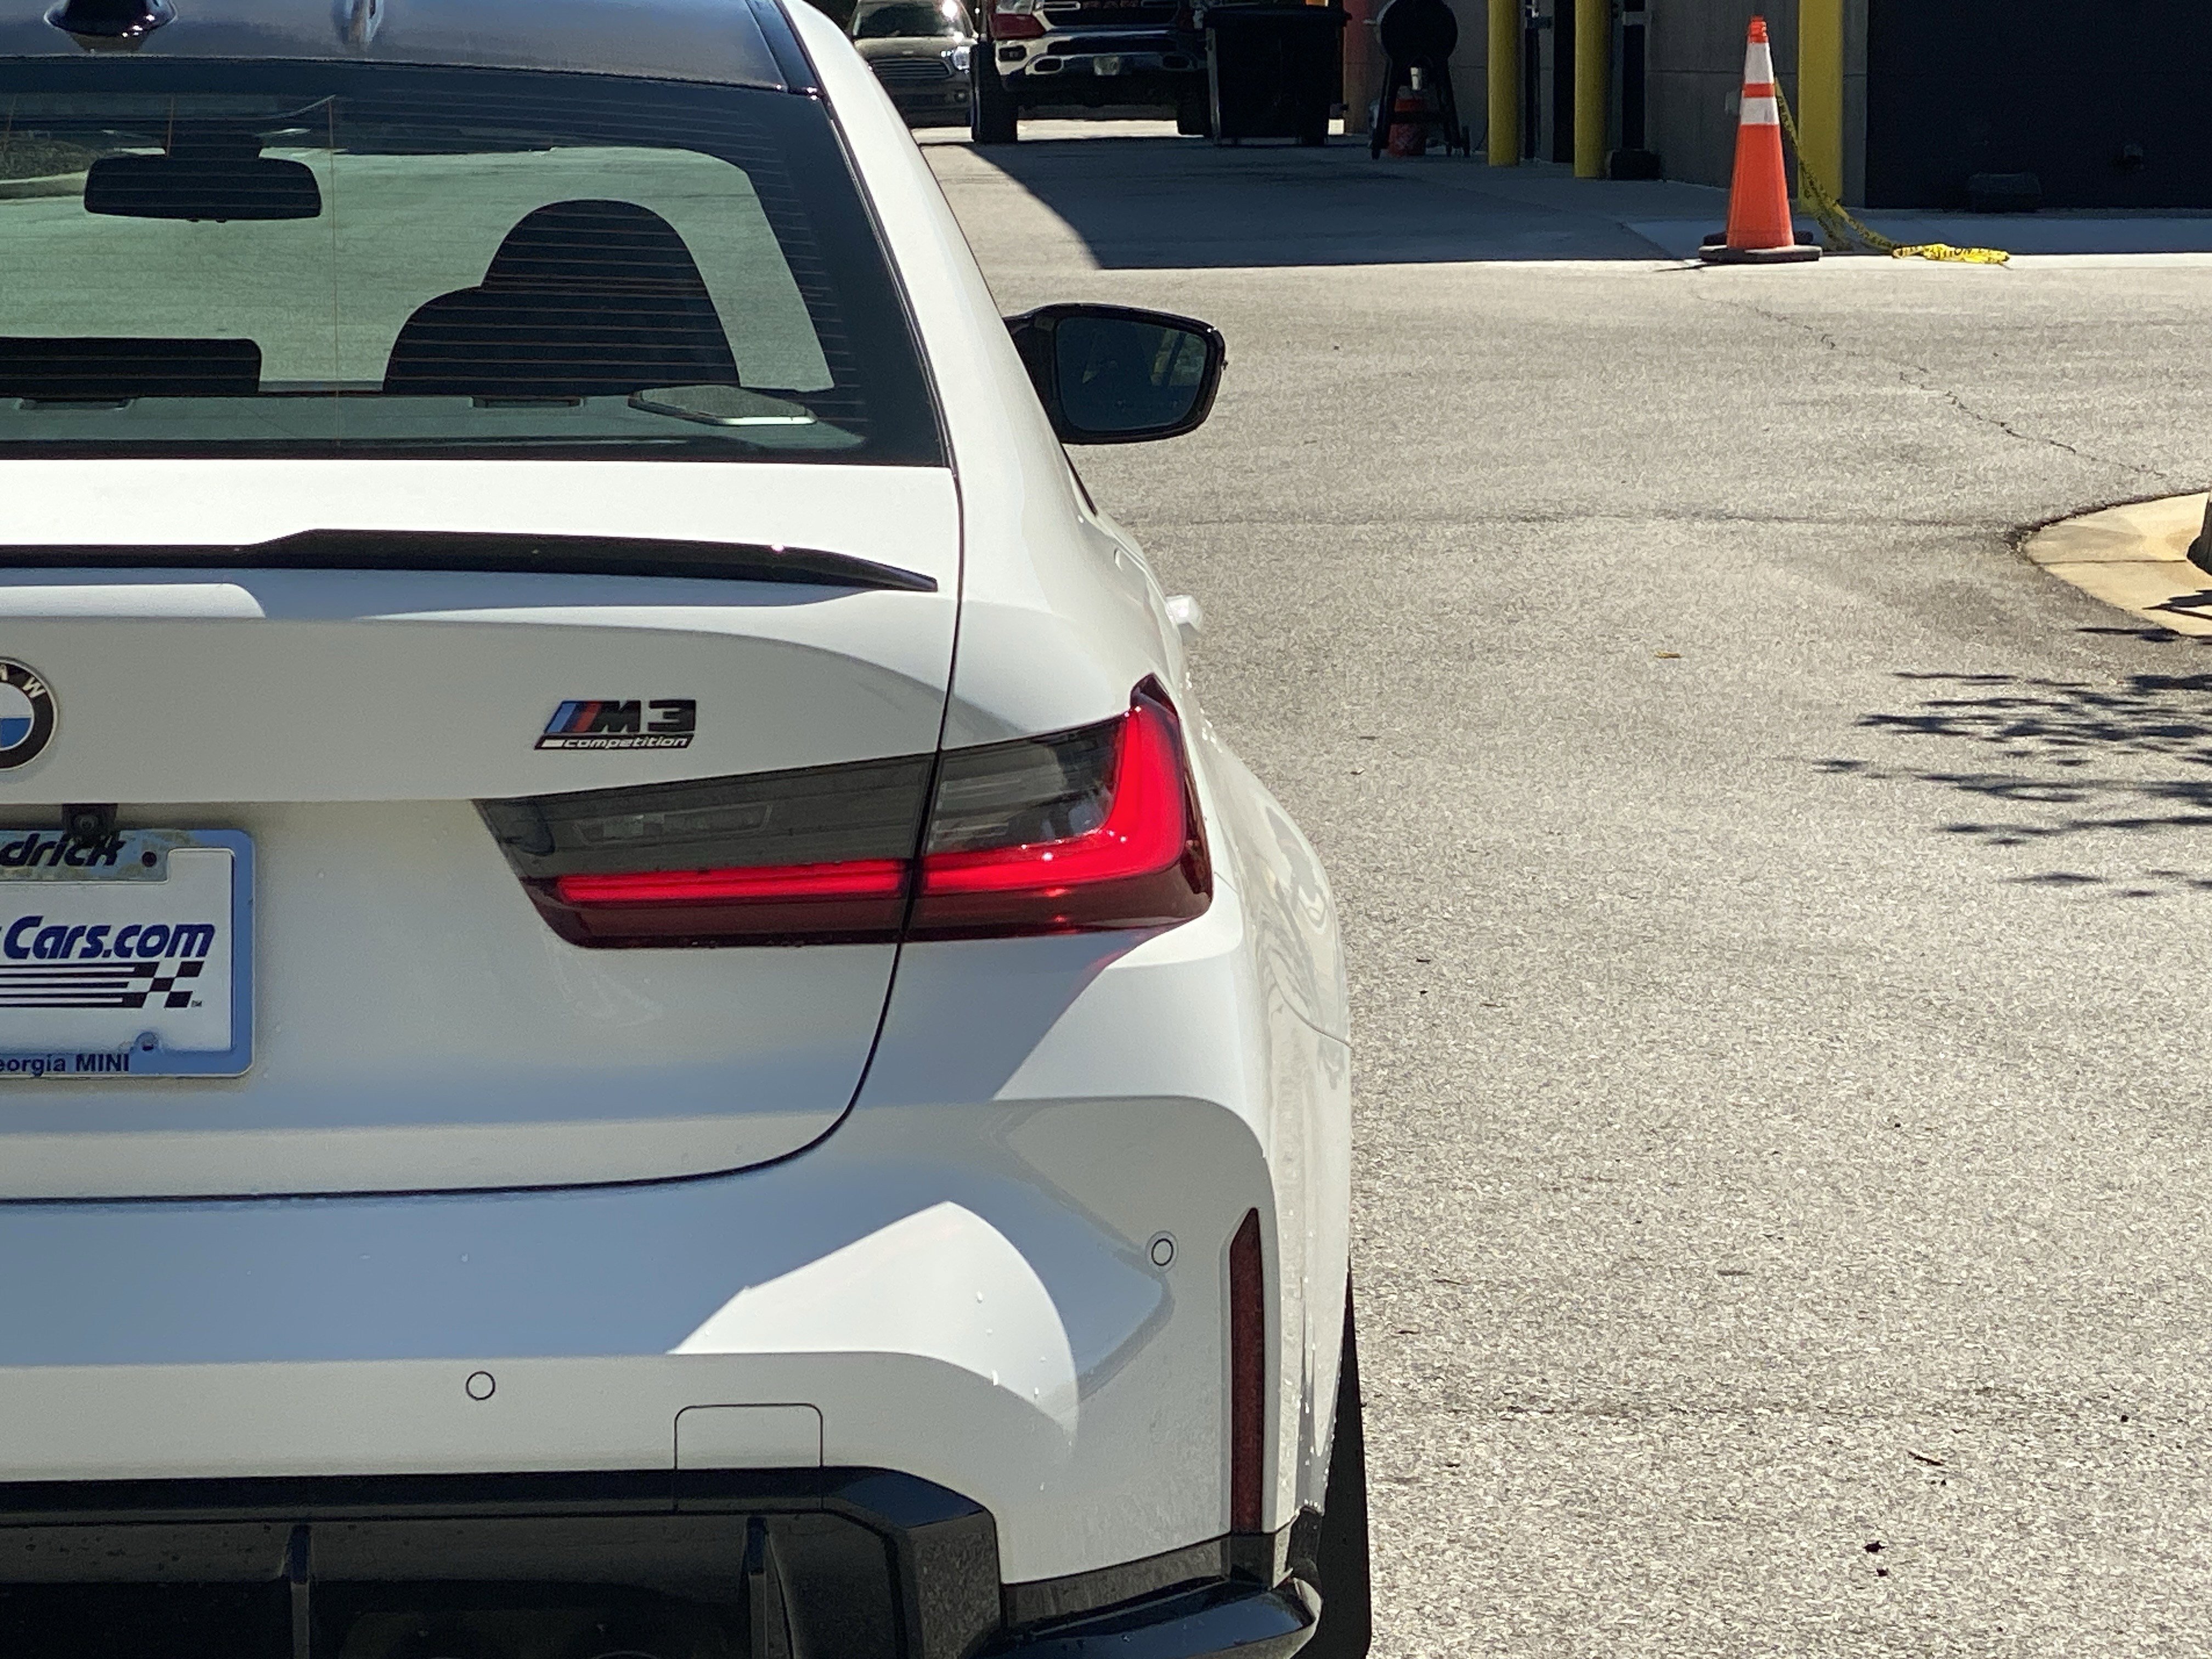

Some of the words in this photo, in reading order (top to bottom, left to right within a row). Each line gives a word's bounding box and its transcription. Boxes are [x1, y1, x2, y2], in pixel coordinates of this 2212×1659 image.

[564, 736, 687, 749] competition
[0, 915, 215, 959] Cars.com
[76, 1053, 129, 1072] MINI
